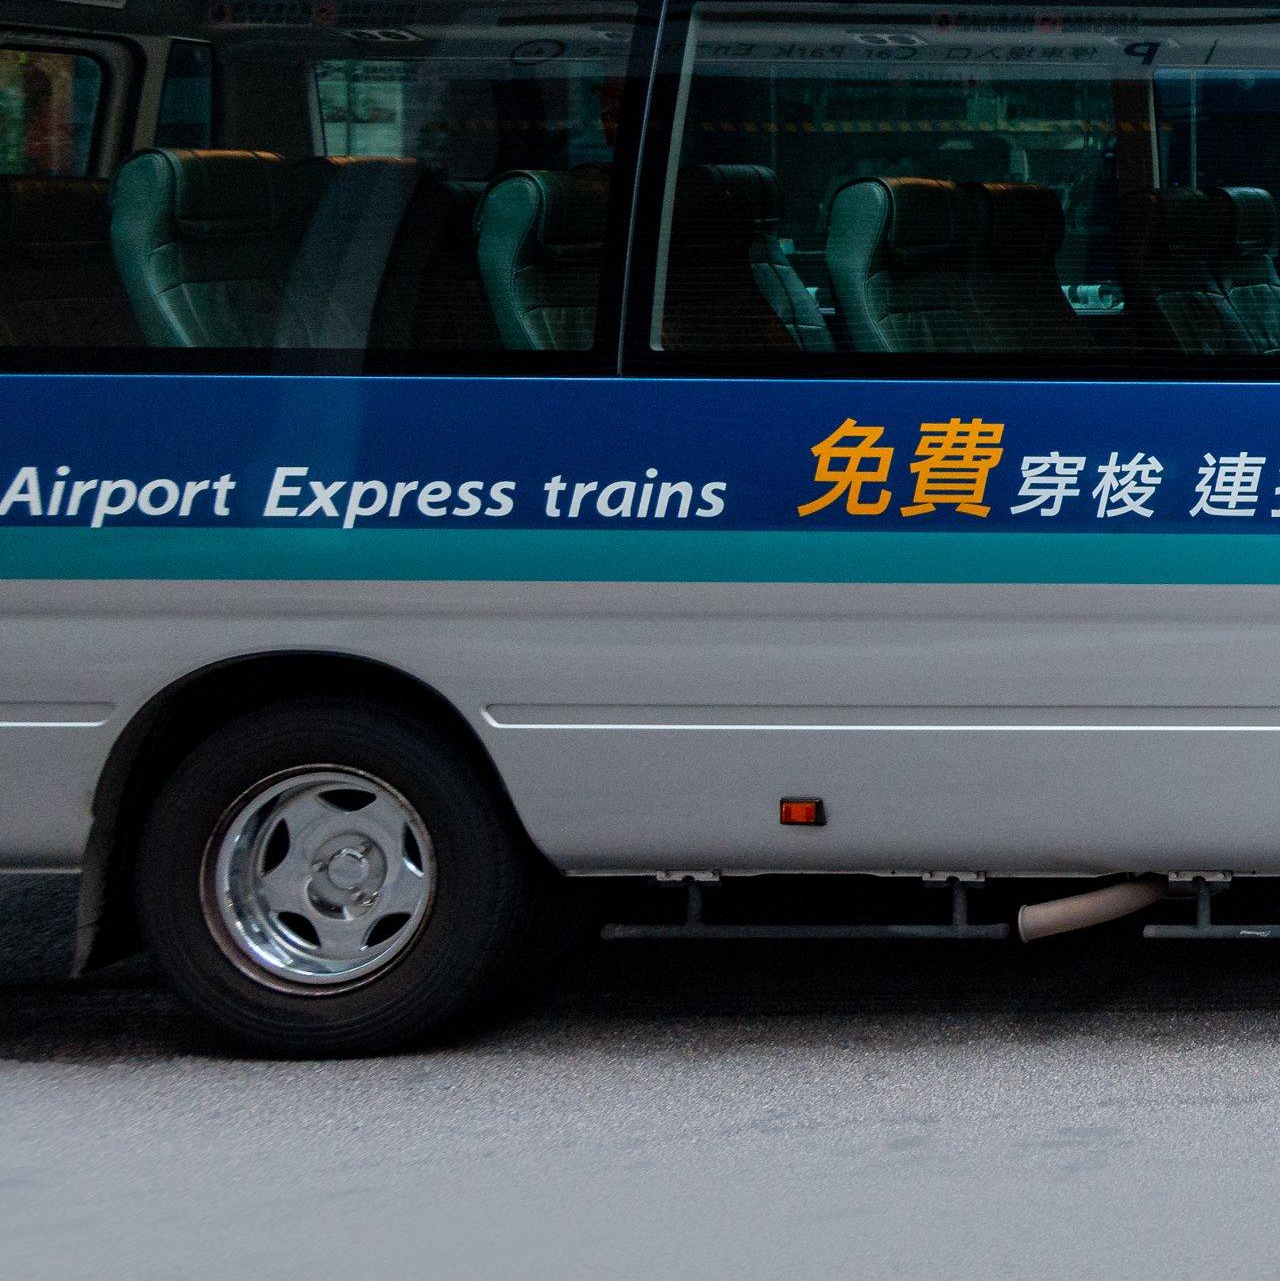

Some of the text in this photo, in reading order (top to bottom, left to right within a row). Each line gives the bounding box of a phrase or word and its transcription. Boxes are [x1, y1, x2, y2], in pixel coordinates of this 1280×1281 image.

[0, 465, 727, 529] Airport Express trains
